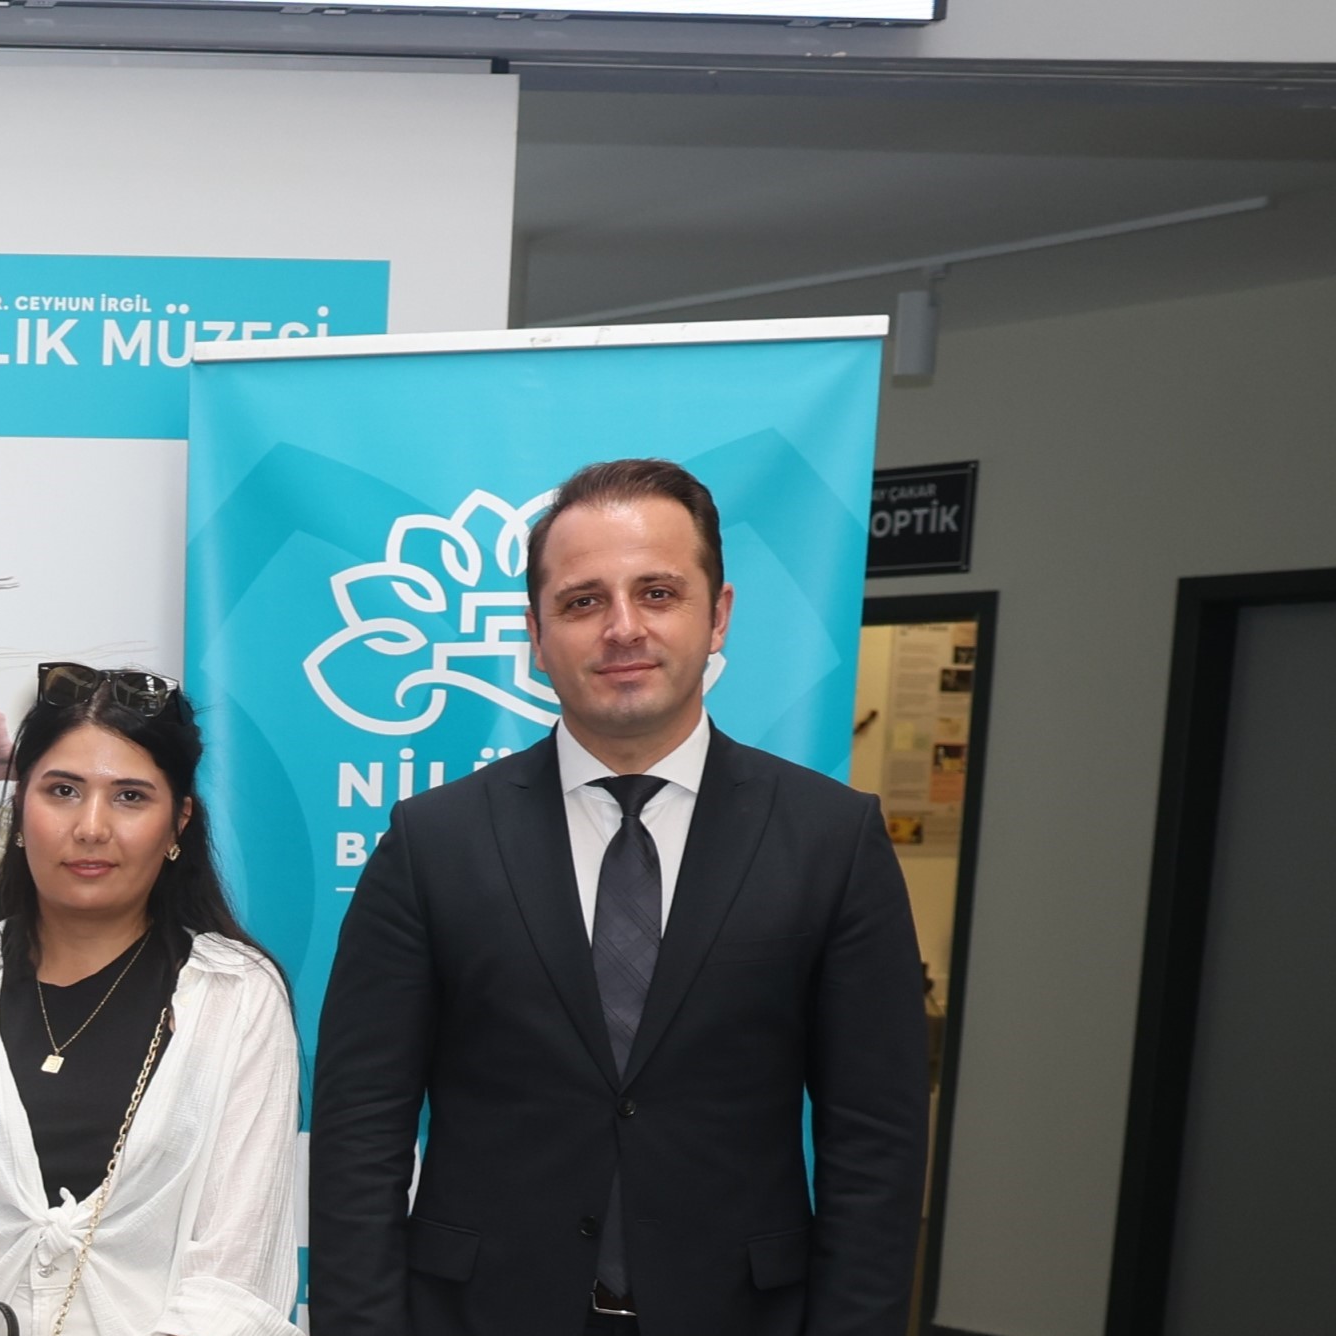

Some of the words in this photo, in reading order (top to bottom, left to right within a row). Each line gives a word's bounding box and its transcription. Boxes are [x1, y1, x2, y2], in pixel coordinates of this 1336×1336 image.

[15, 296, 96, 312] CEYHUN
[100, 293, 152, 314] İRGİL
[889, 483, 937, 503] ÇAKAR
[871, 498, 960, 538] OPTİK
